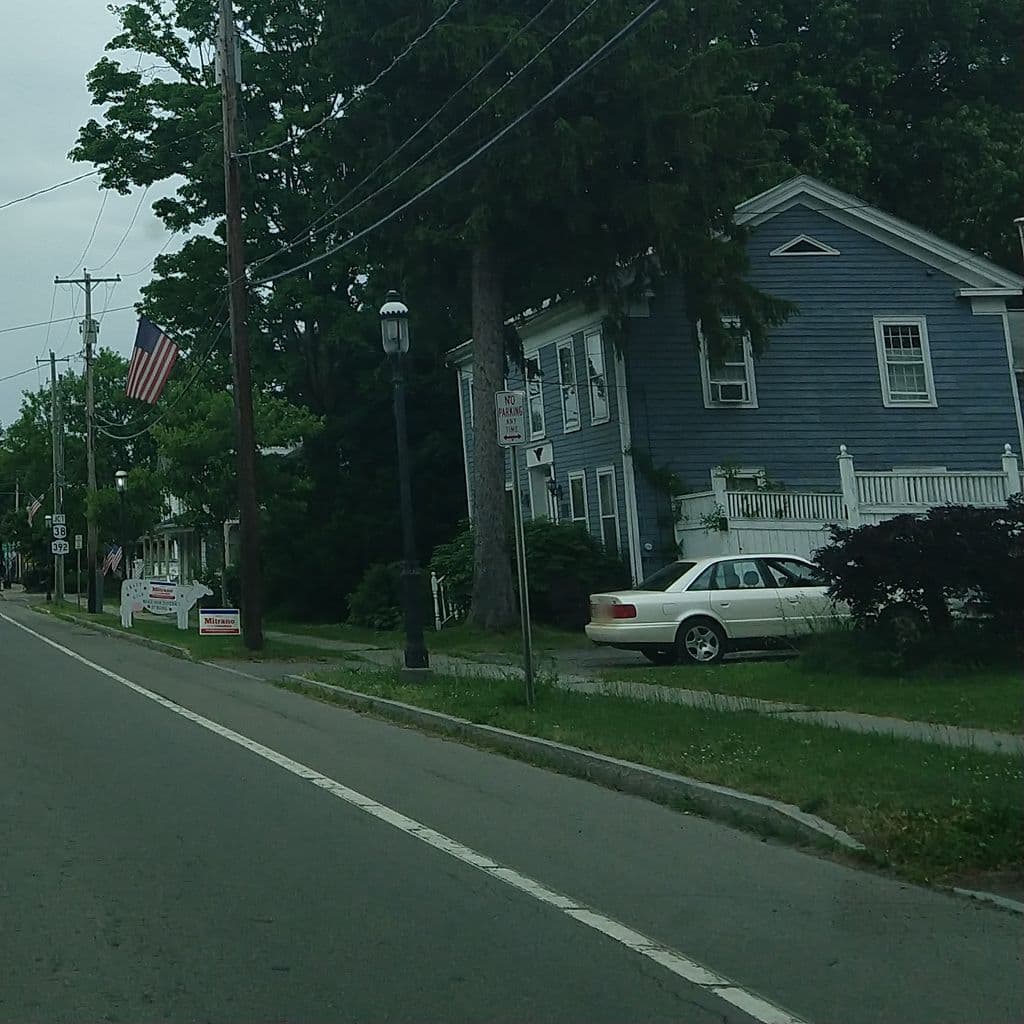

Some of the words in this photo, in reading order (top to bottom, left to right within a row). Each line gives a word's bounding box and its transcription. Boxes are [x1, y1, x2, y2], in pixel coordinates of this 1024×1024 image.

[504, 395, 516, 405] NO
[498, 406, 523, 417] PARKING
[54, 527, 66, 536] 38
[53, 543, 68, 552] 392
[204, 617, 236, 625] Mitrano
